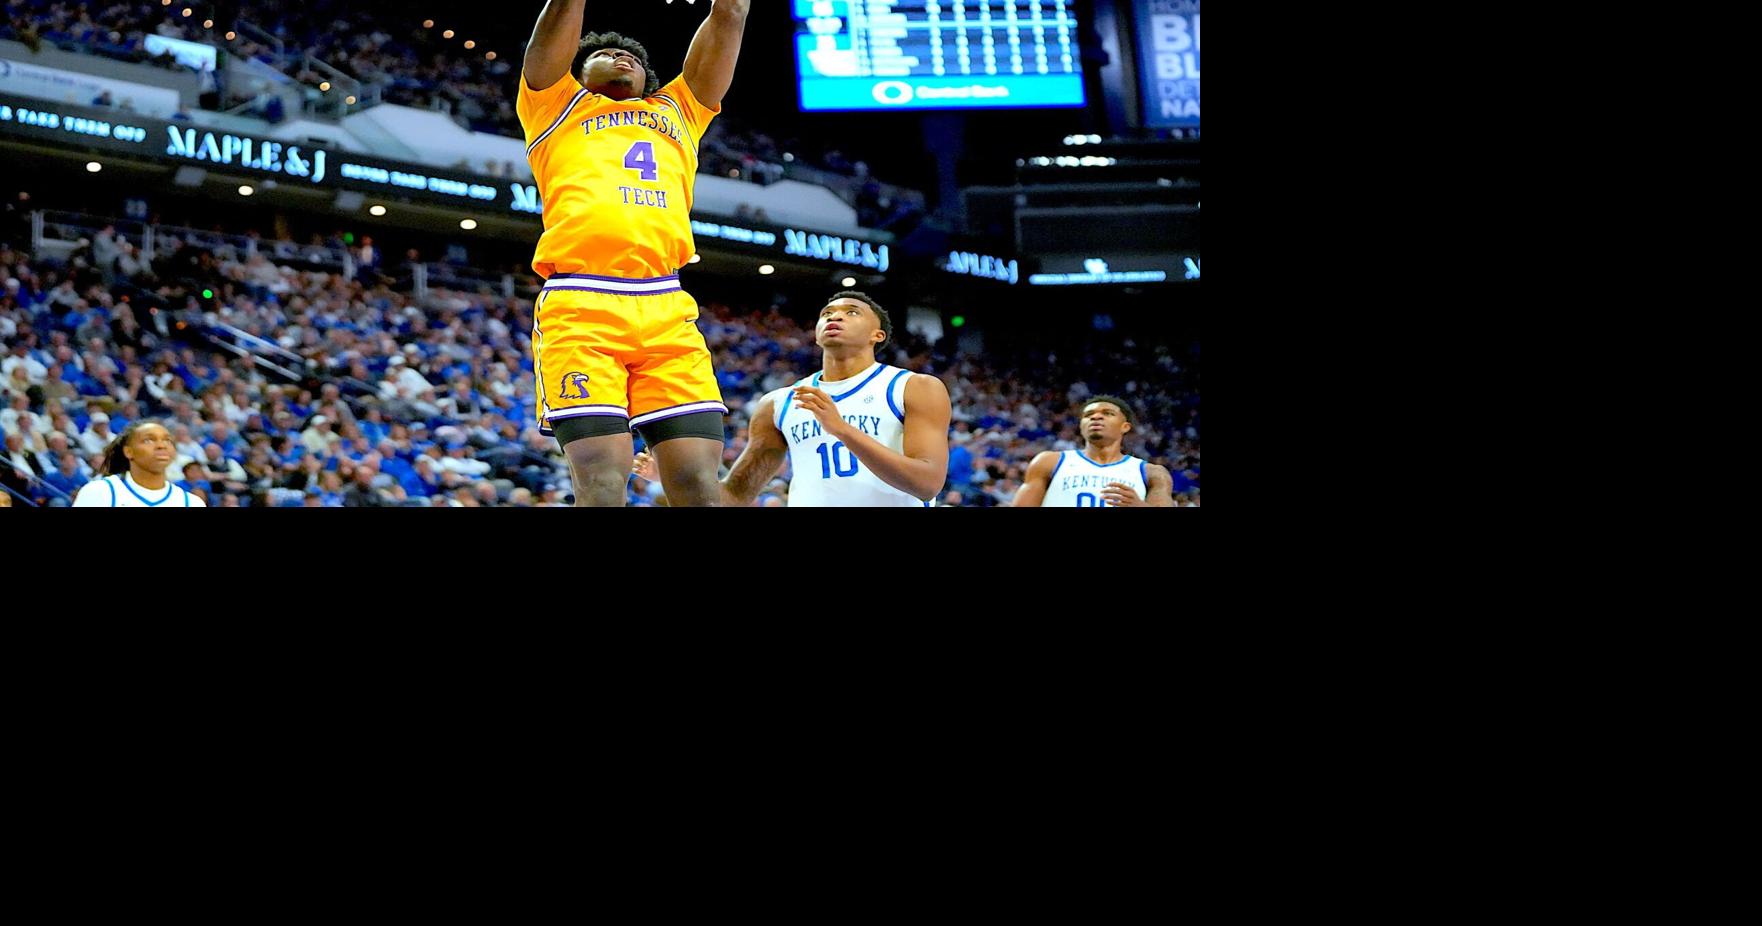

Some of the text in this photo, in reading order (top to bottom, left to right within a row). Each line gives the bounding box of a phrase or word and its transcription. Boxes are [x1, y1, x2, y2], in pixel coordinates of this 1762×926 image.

[1151, 14, 1200, 52] B
[1158, 80, 1200, 99] DE
[623, 140, 659, 182] 4
[618, 185, 668, 209] TECH
[790, 414, 881, 445] KENCKY
[815, 440, 859, 479] 10
